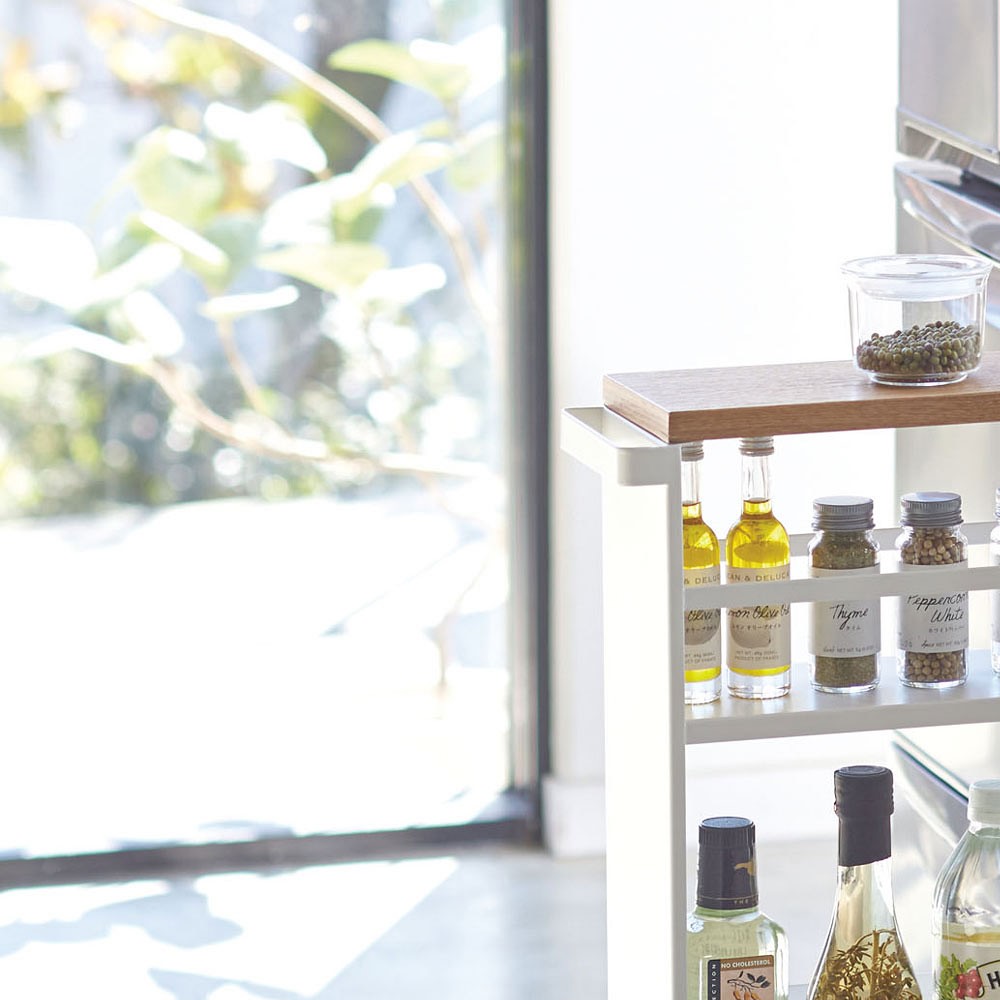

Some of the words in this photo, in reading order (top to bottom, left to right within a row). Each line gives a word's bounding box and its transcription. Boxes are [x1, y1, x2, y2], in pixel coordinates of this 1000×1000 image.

[695, 574, 721, 584] DELUC
[829, 604, 869, 630] Thyme
[930, 607, 964, 623] White
[732, 959, 771, 968] CHOLESTEROL
